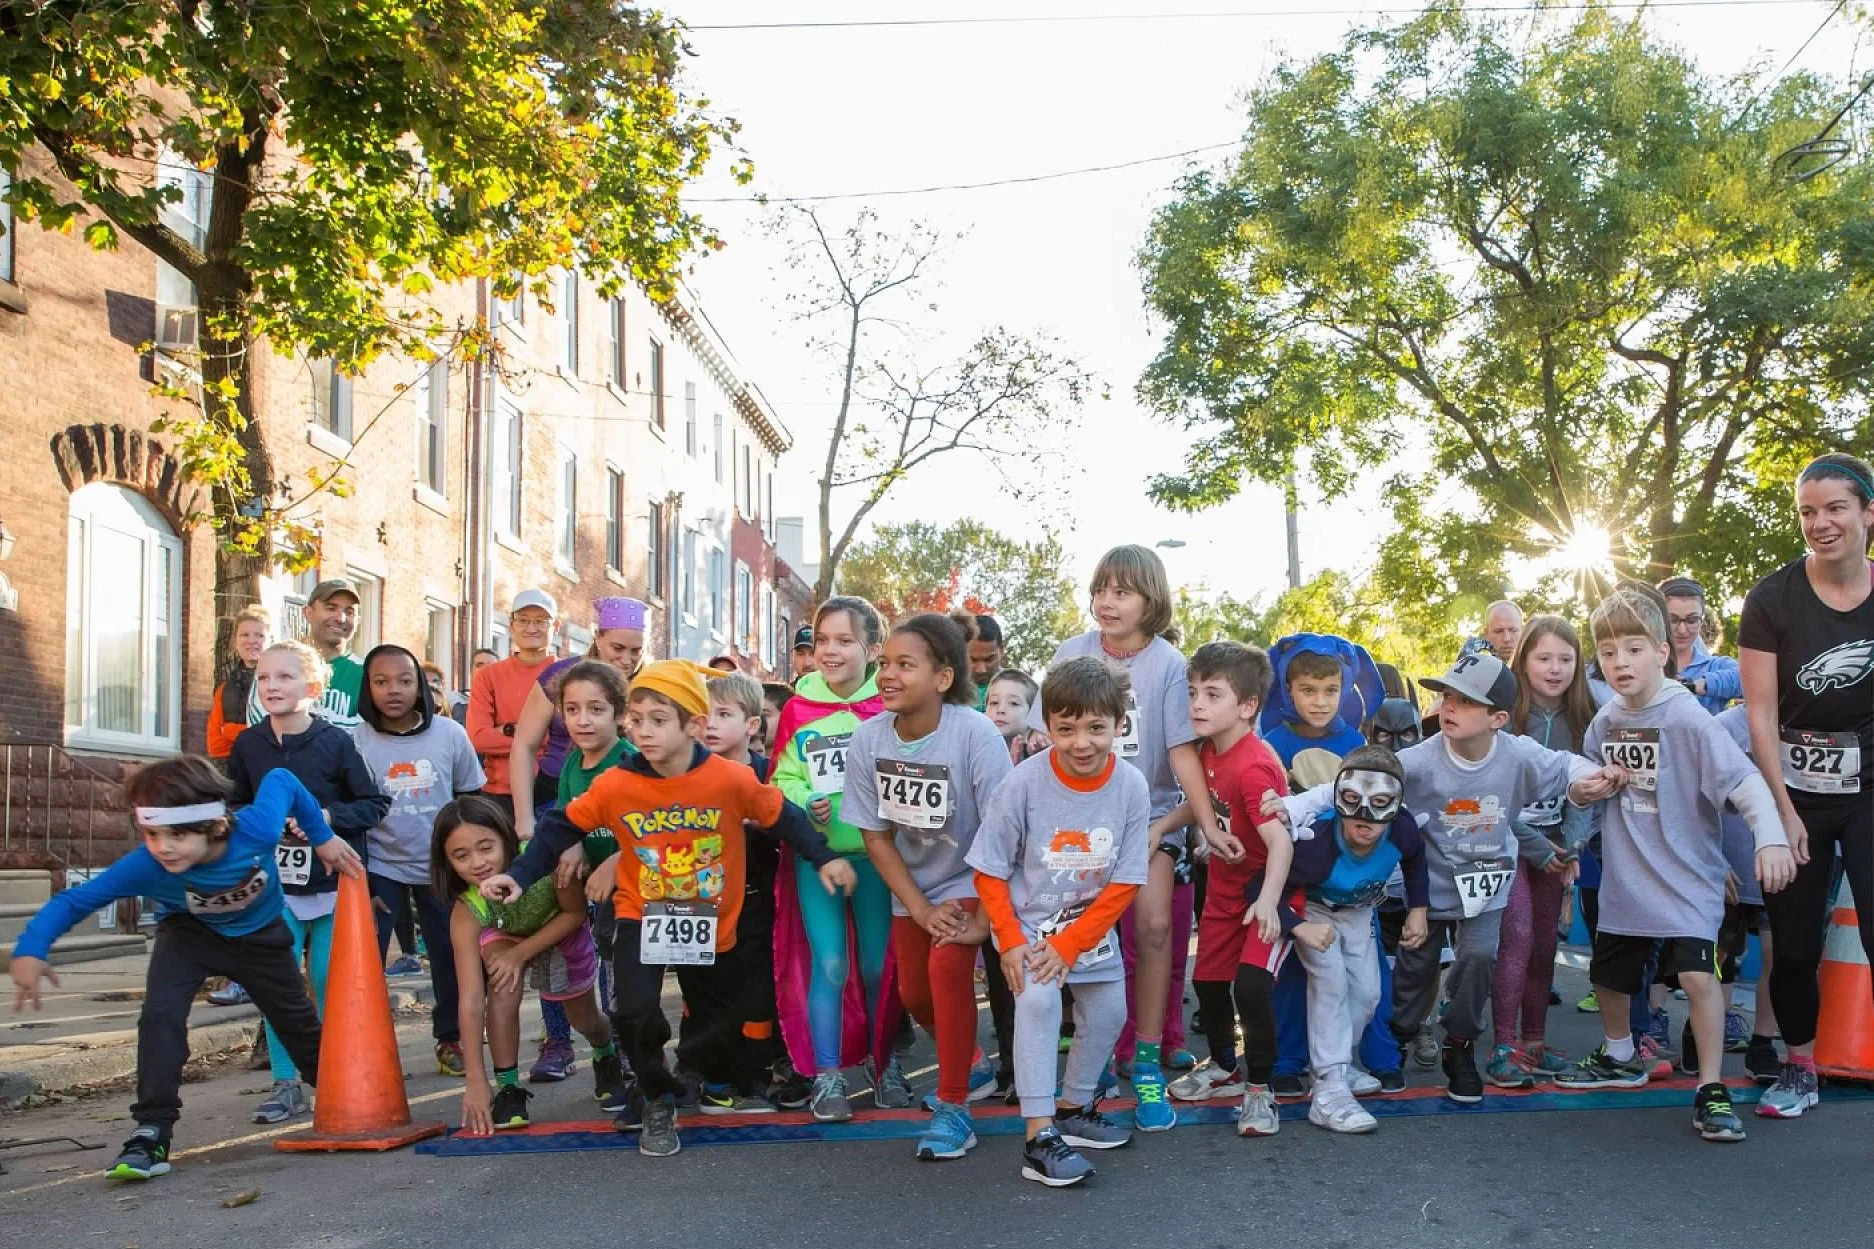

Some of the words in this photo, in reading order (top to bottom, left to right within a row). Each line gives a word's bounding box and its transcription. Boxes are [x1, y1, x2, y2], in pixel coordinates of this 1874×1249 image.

[1454, 655, 1479, 674] T
[812, 750, 849, 777] 74
[1605, 744, 1656, 770] 7492
[1790, 745, 1845, 774] 927
[880, 775, 943, 809] 7476
[1461, 872, 1512, 898] 747
[646, 917, 712, 945] 7498
